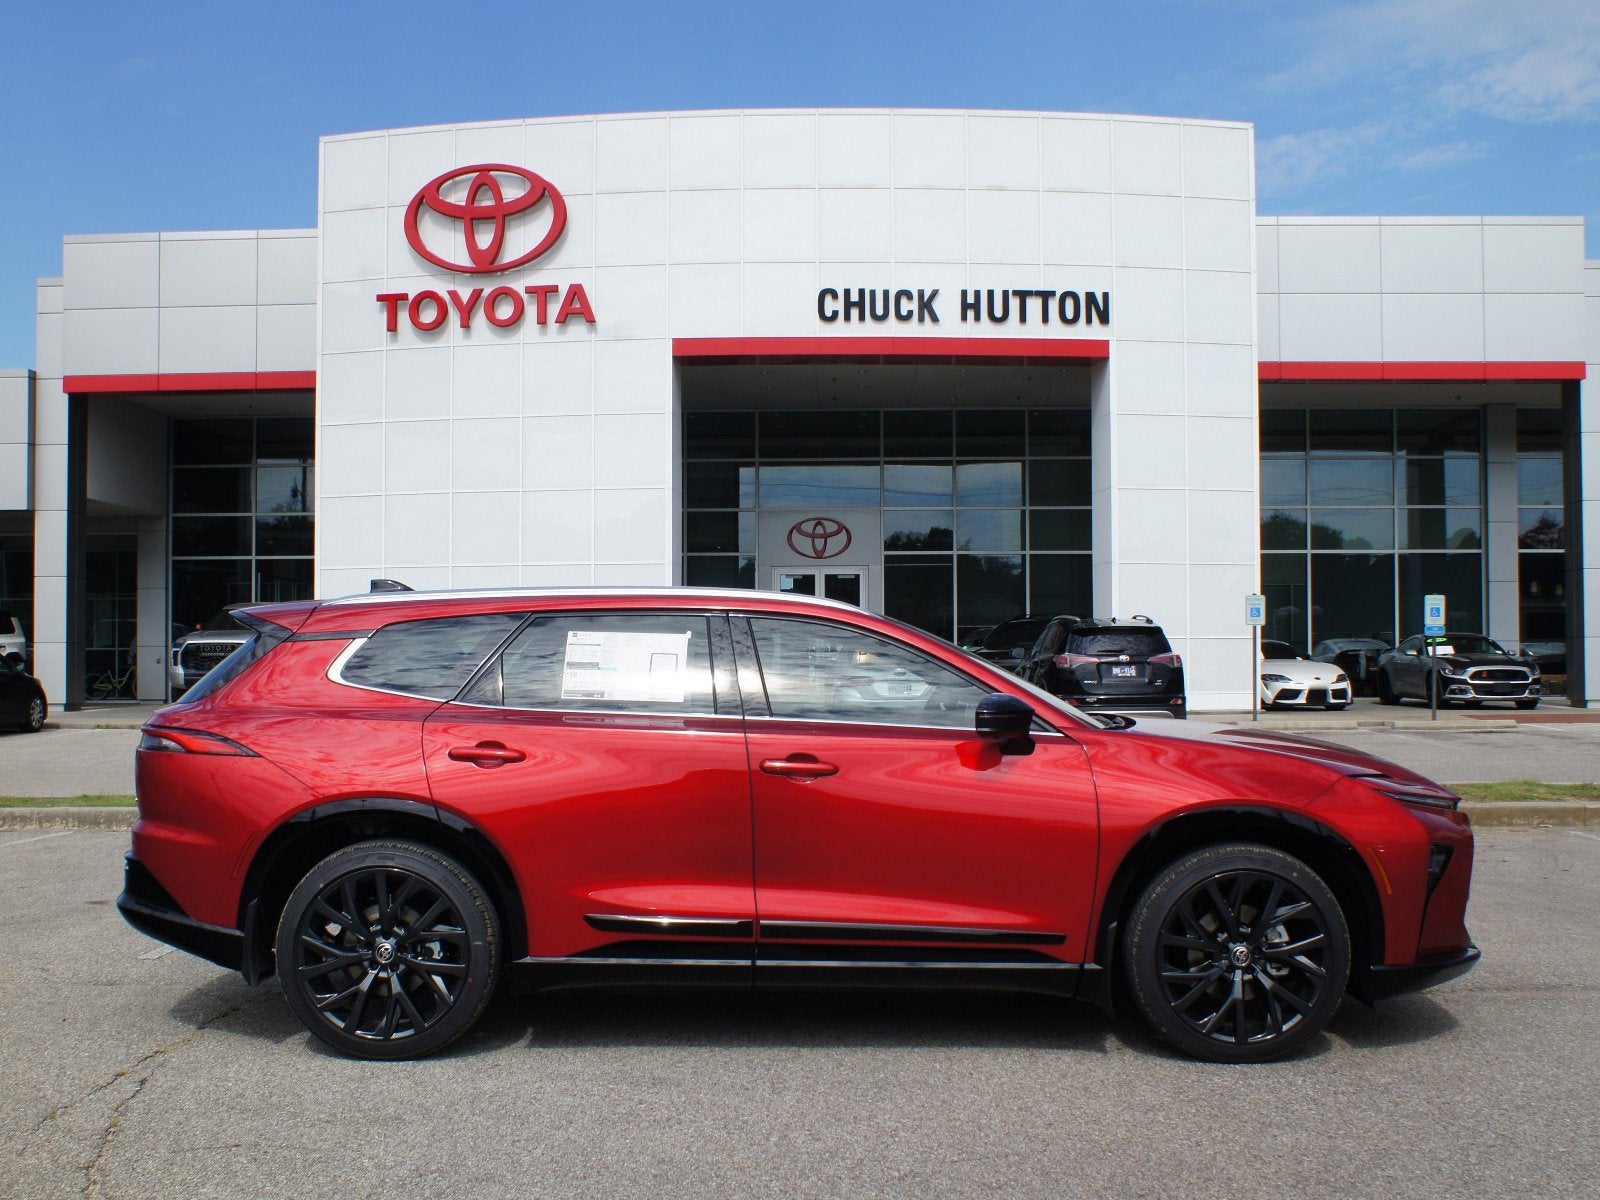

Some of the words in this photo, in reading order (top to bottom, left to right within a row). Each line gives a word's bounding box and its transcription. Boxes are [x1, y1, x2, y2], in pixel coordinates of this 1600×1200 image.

[376, 283, 597, 332] TOYOTA
[817, 287, 940, 323] CHUCK
[960, 289, 1110, 325] HUTTON
